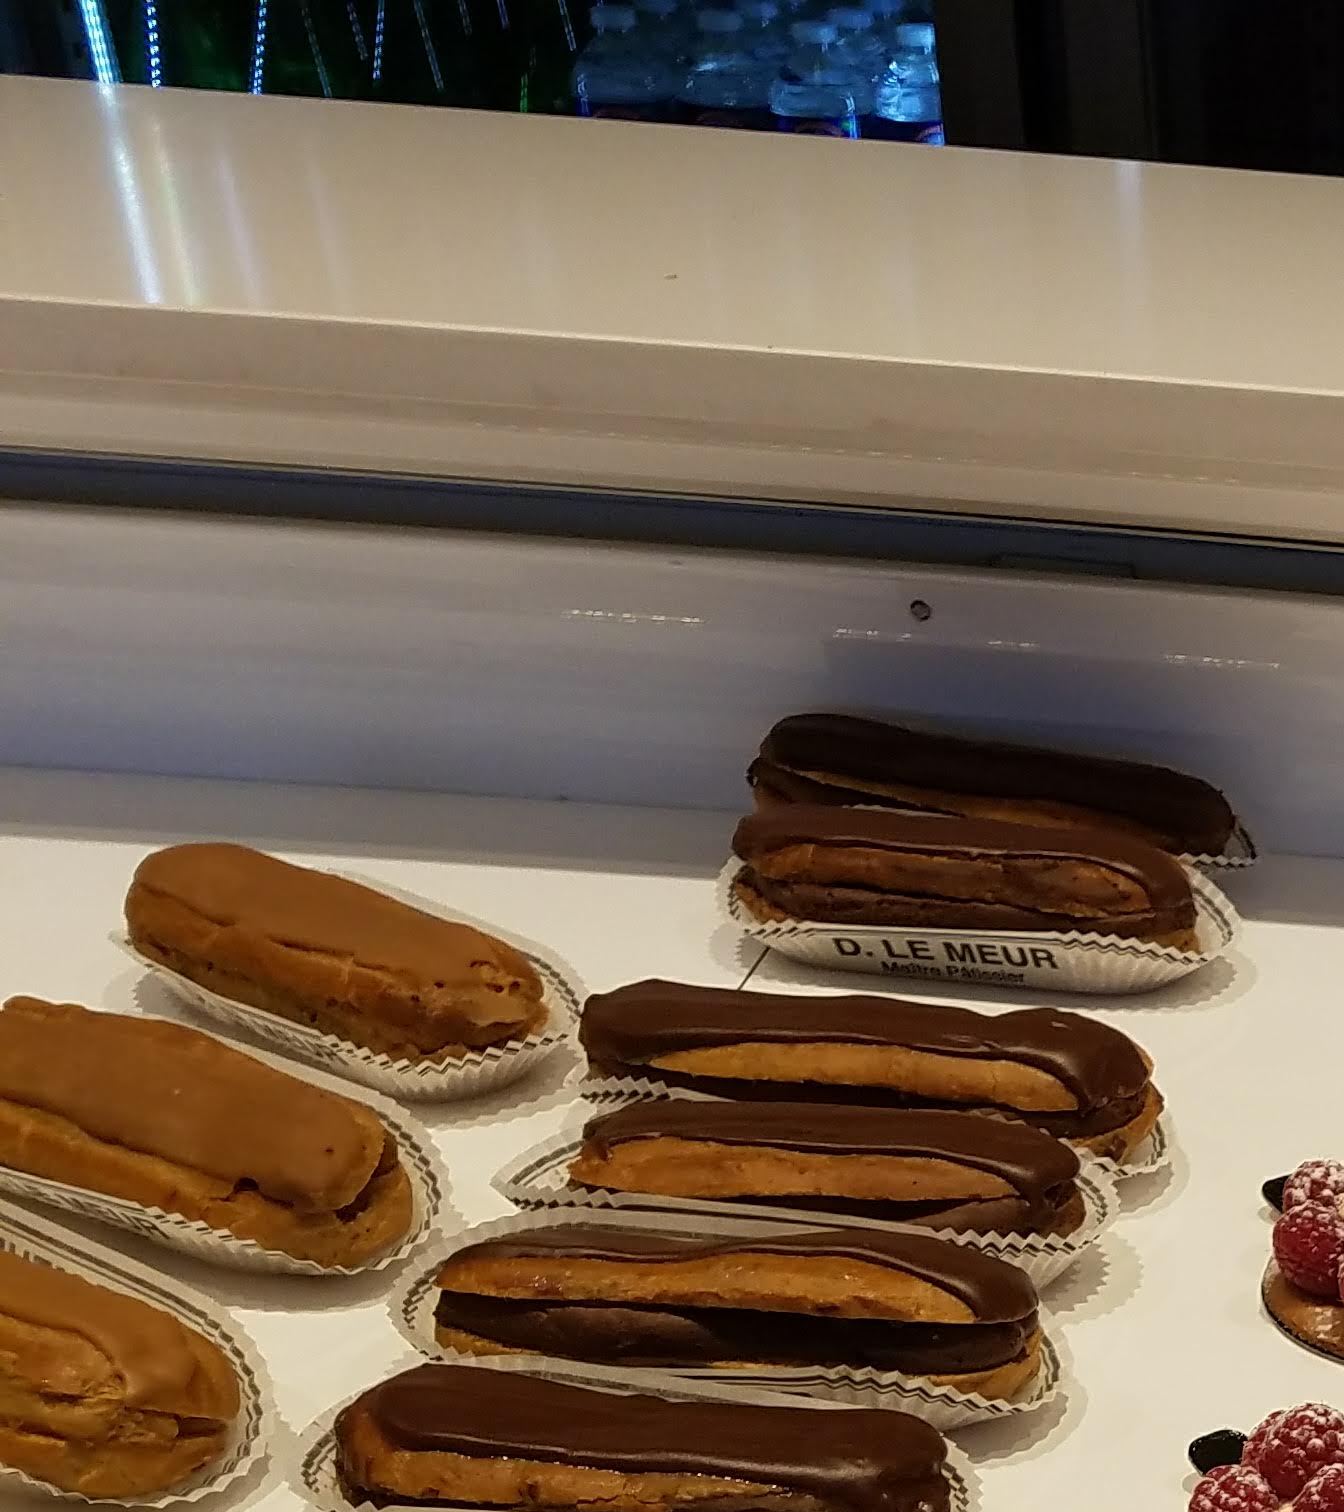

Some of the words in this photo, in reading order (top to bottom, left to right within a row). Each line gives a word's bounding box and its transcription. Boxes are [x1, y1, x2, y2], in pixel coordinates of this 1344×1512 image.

[832, 937, 873, 957] D.
[881, 939, 935, 961] LE
[942, 941, 1060, 970] MEUR
